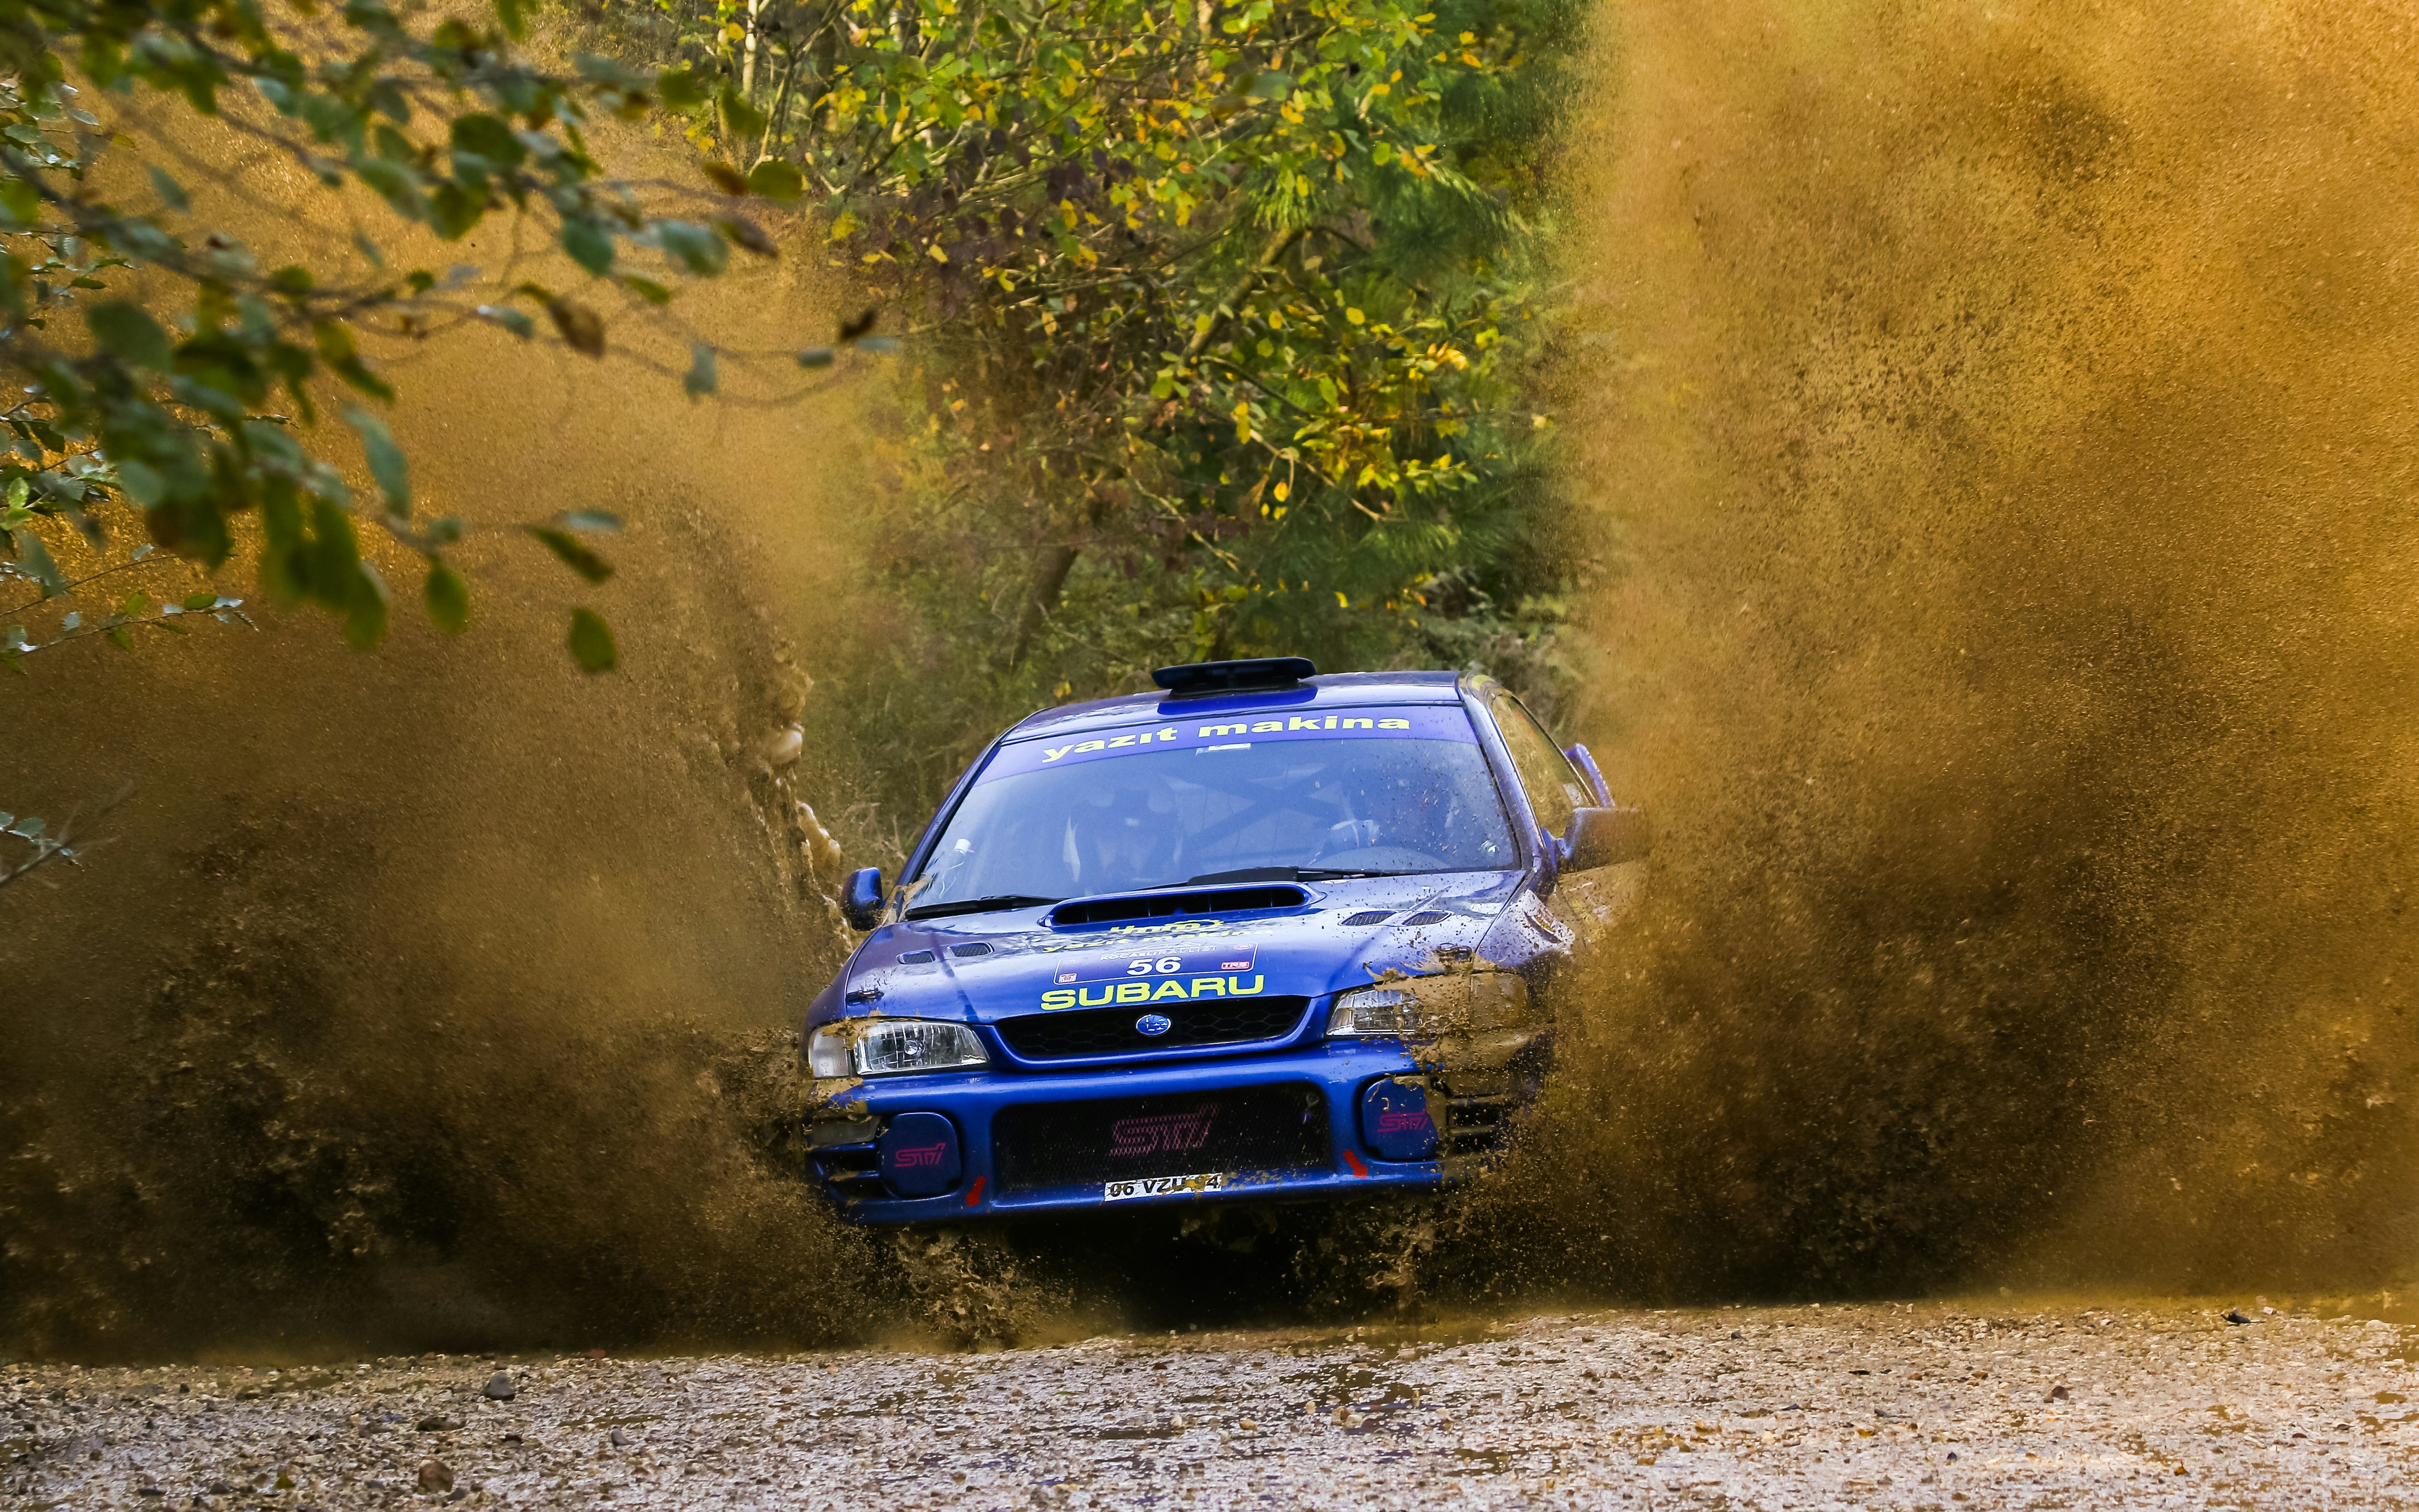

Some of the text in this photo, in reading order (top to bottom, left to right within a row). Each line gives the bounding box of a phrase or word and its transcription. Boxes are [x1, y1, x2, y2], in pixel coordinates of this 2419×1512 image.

[1198, 716, 1410, 737] makina
[1126, 956, 1182, 976] 56
[1041, 975, 1265, 1010] SUBARU
[1110, 1183, 1134, 1198] 06
